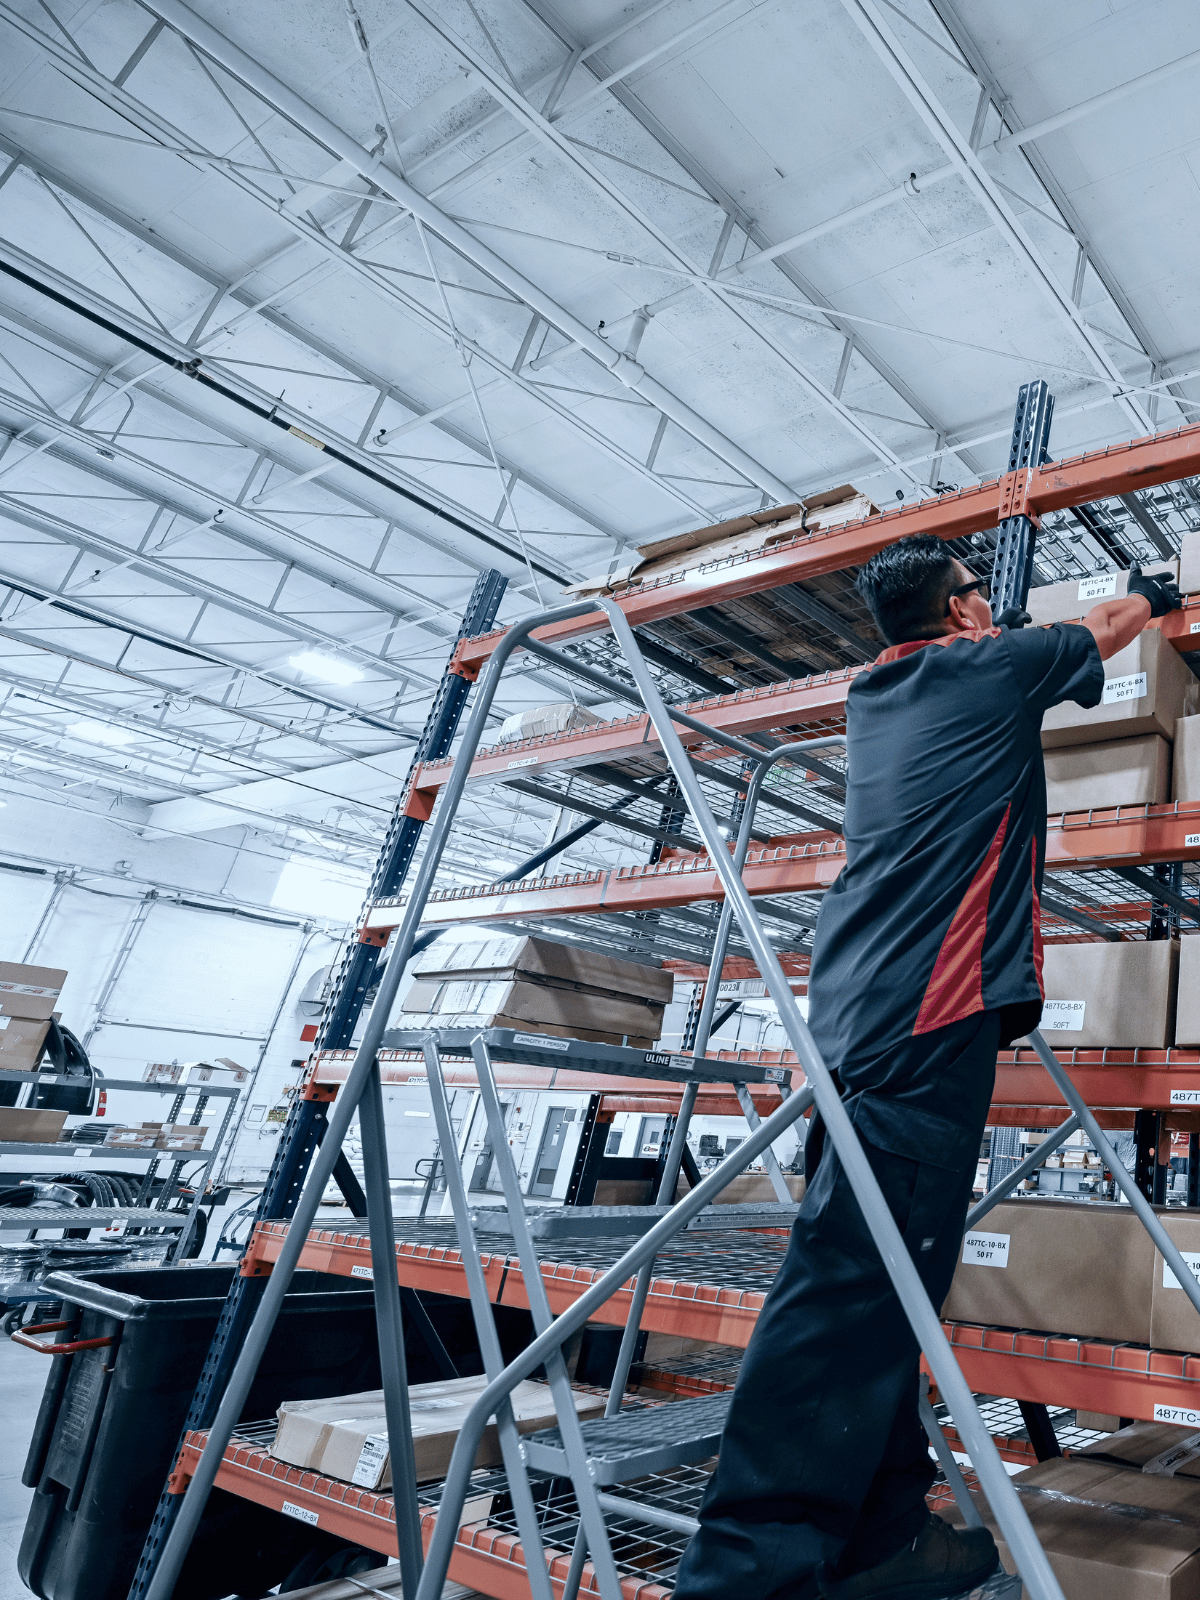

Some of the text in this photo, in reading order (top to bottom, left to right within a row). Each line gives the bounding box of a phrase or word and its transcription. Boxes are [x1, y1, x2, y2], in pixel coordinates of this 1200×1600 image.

[1080, 576, 1114, 586] 487TC-4-BX
[1086, 587, 1106, 597] 50 FT
[1105, 677, 1145, 691] 487TC-6-BX
[1116, 688, 1134, 698] 50 FT
[1044, 1002, 1084, 1011] 487TC-8-BX
[1052, 1021, 1070, 1029] 50FT
[645, 1053, 670, 1065] ULINE
[966, 1239, 1007, 1250] 487TC-10-BX
[976, 1250, 985, 1258] 50
[283, 1504, 318, 1523] 471TC-12-BX
